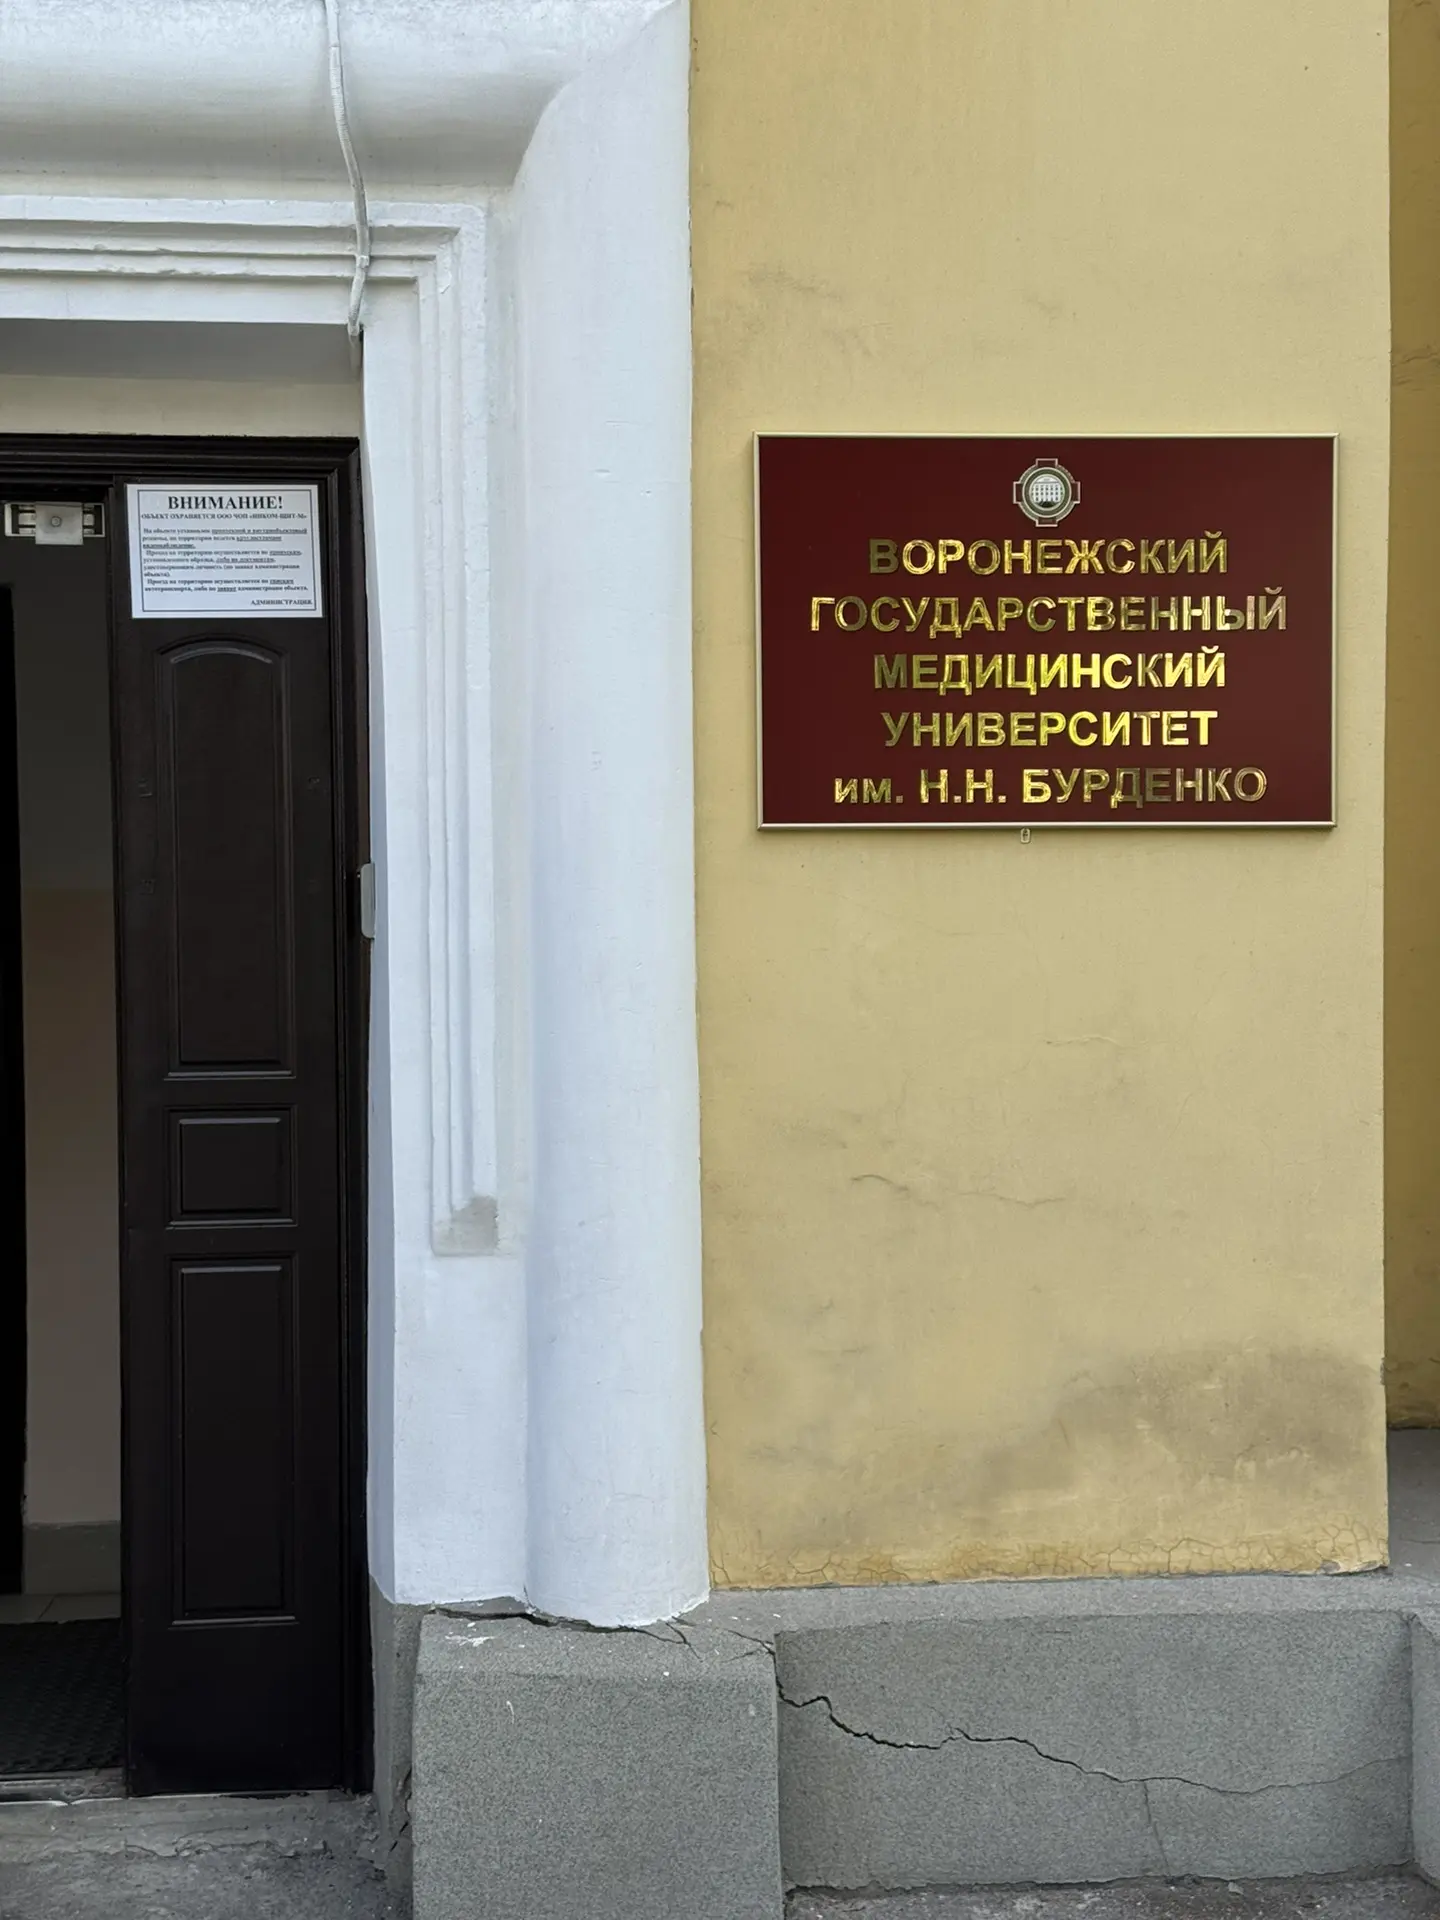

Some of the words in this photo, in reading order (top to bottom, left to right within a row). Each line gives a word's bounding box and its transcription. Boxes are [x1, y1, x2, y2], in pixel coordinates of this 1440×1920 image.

[167, 495, 283, 510] ВНИМАНИЕ!
[869, 530, 1229, 576] ВОРОНЕЖСКИЙ
[810, 586, 1288, 640] ГОСУДАРСТВЕННЫЙ
[873, 645, 1227, 696] МЕДИЦИНСКИЙ
[880, 709, 1219, 748] УНИВЕРСИТЕТ
[833, 777, 904, 804] им.
[920, 767, 1007, 804] Н.Н.
[1021, 766, 1268, 809] БУРДЕНКО
